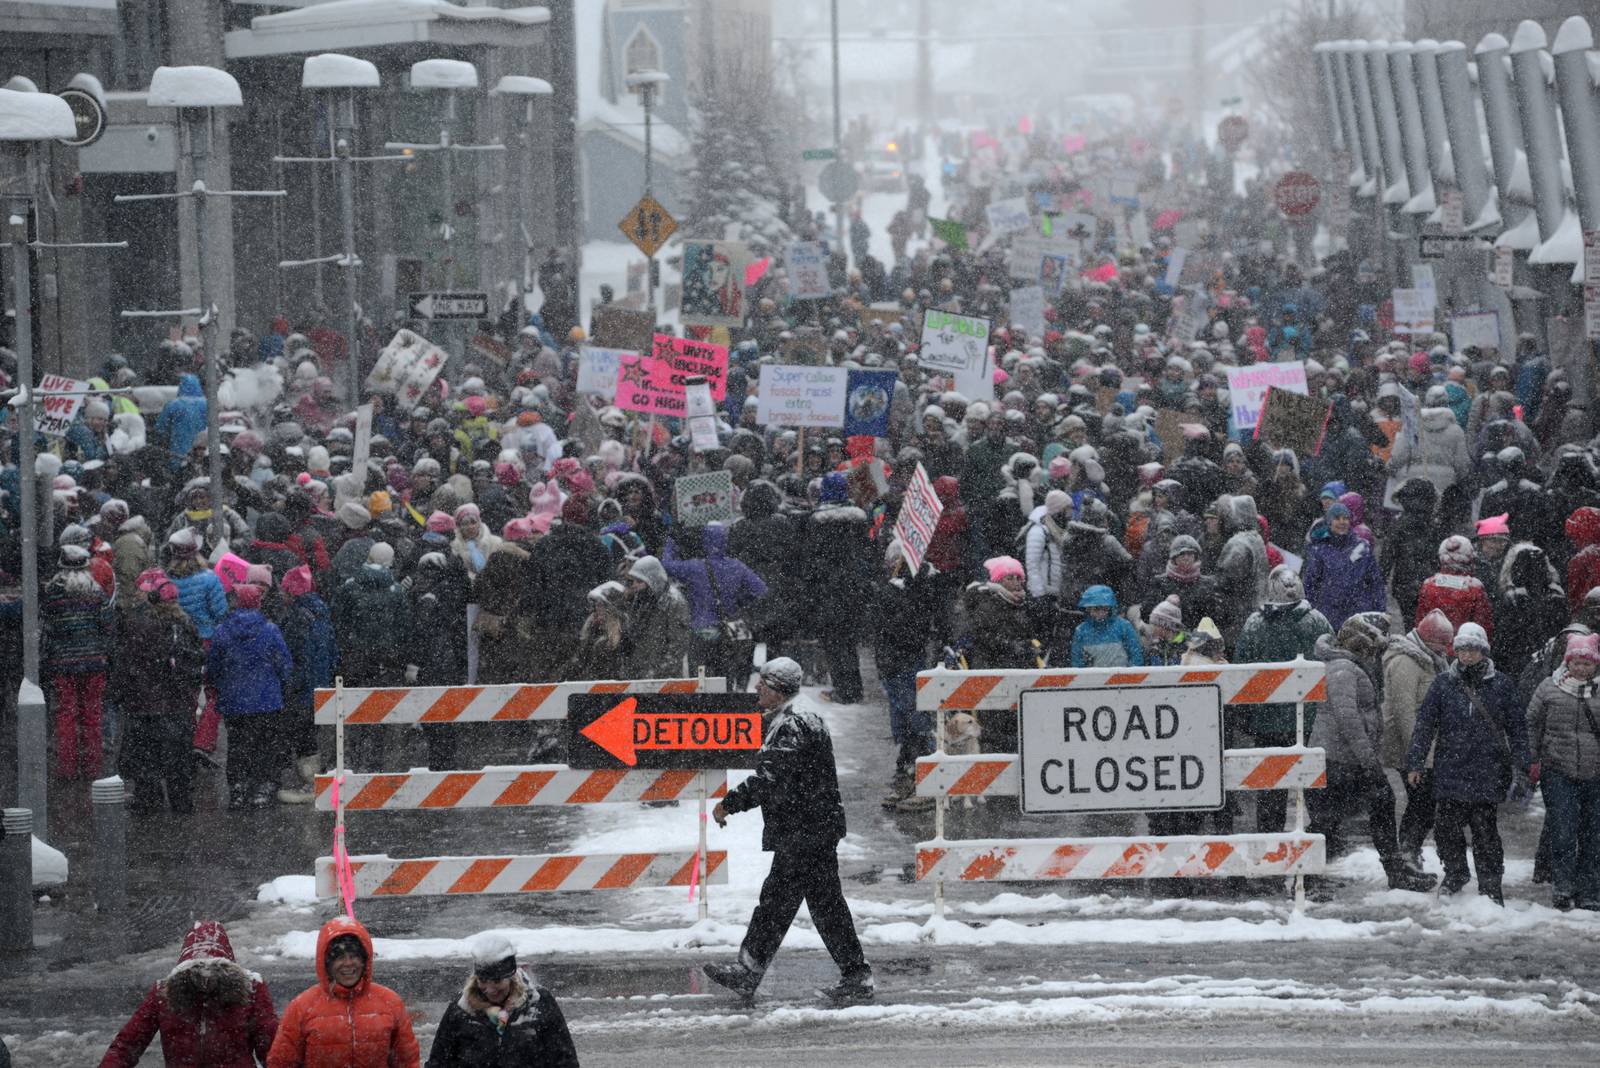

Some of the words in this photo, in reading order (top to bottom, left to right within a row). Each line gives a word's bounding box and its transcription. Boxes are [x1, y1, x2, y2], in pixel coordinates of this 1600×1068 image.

[43, 375, 75, 391] LIVE
[772, 367, 804, 386] Super
[42, 394, 75, 414] OPE
[632, 392, 649, 407] GO
[654, 396, 685, 411] HIGH
[785, 398, 812, 410] extra
[633, 717, 753, 745] DETOUR
[1063, 704, 1180, 743] ROAD
[1040, 755, 1205, 795] CLOSED
